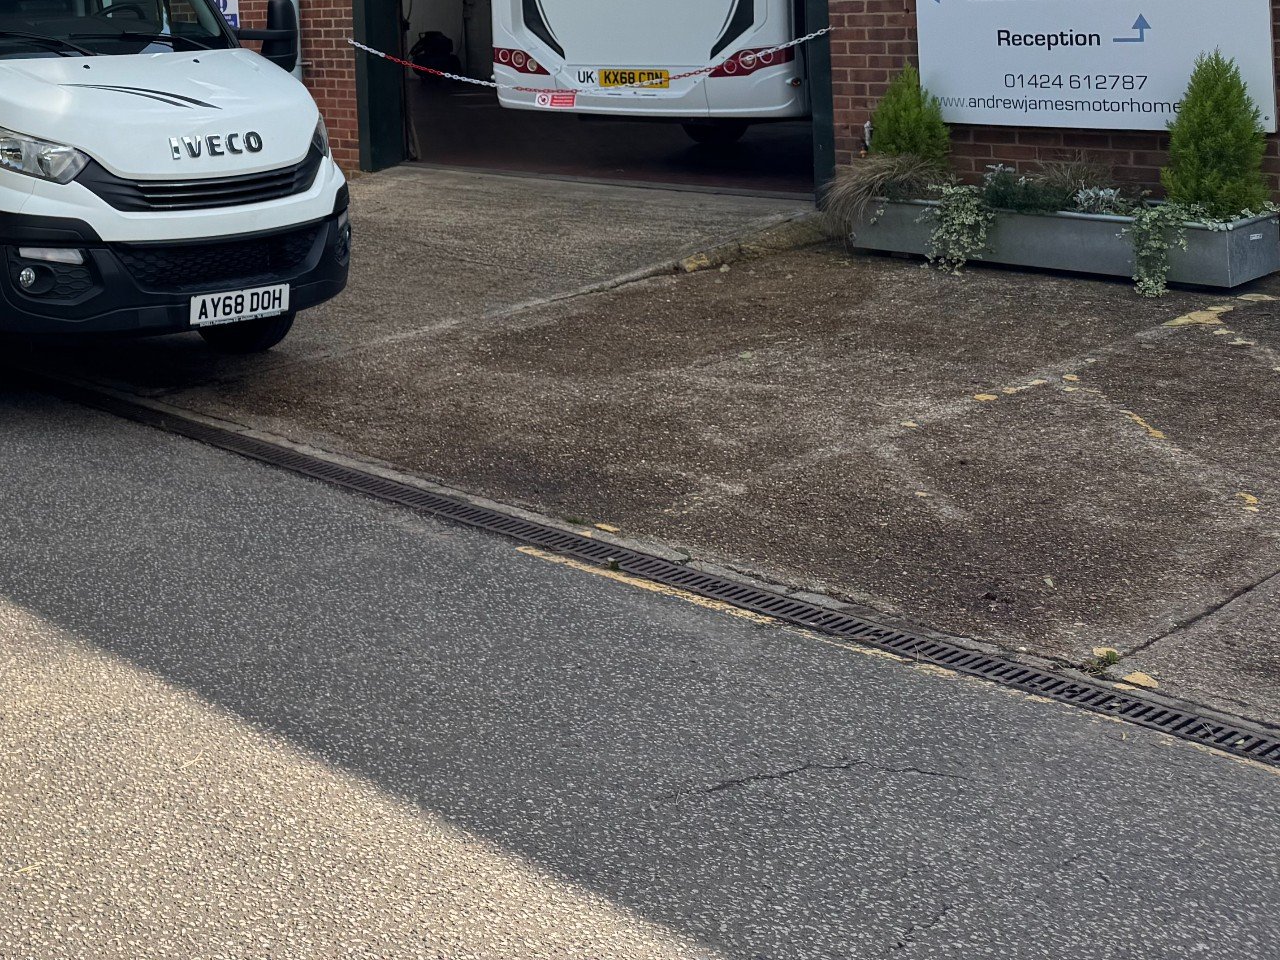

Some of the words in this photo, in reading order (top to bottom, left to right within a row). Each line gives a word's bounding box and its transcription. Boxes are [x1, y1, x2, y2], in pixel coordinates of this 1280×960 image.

[996, 29, 1101, 51] Reception
[577, 70, 594, 84] UK
[604, 71, 635, 85] KX68
[1004, 73, 1064, 90] 01424
[1069, 74, 1148, 91] 612787
[169, 131, 264, 160] IVECO
[198, 294, 245, 320] AY68
[249, 288, 283, 313] DOH
